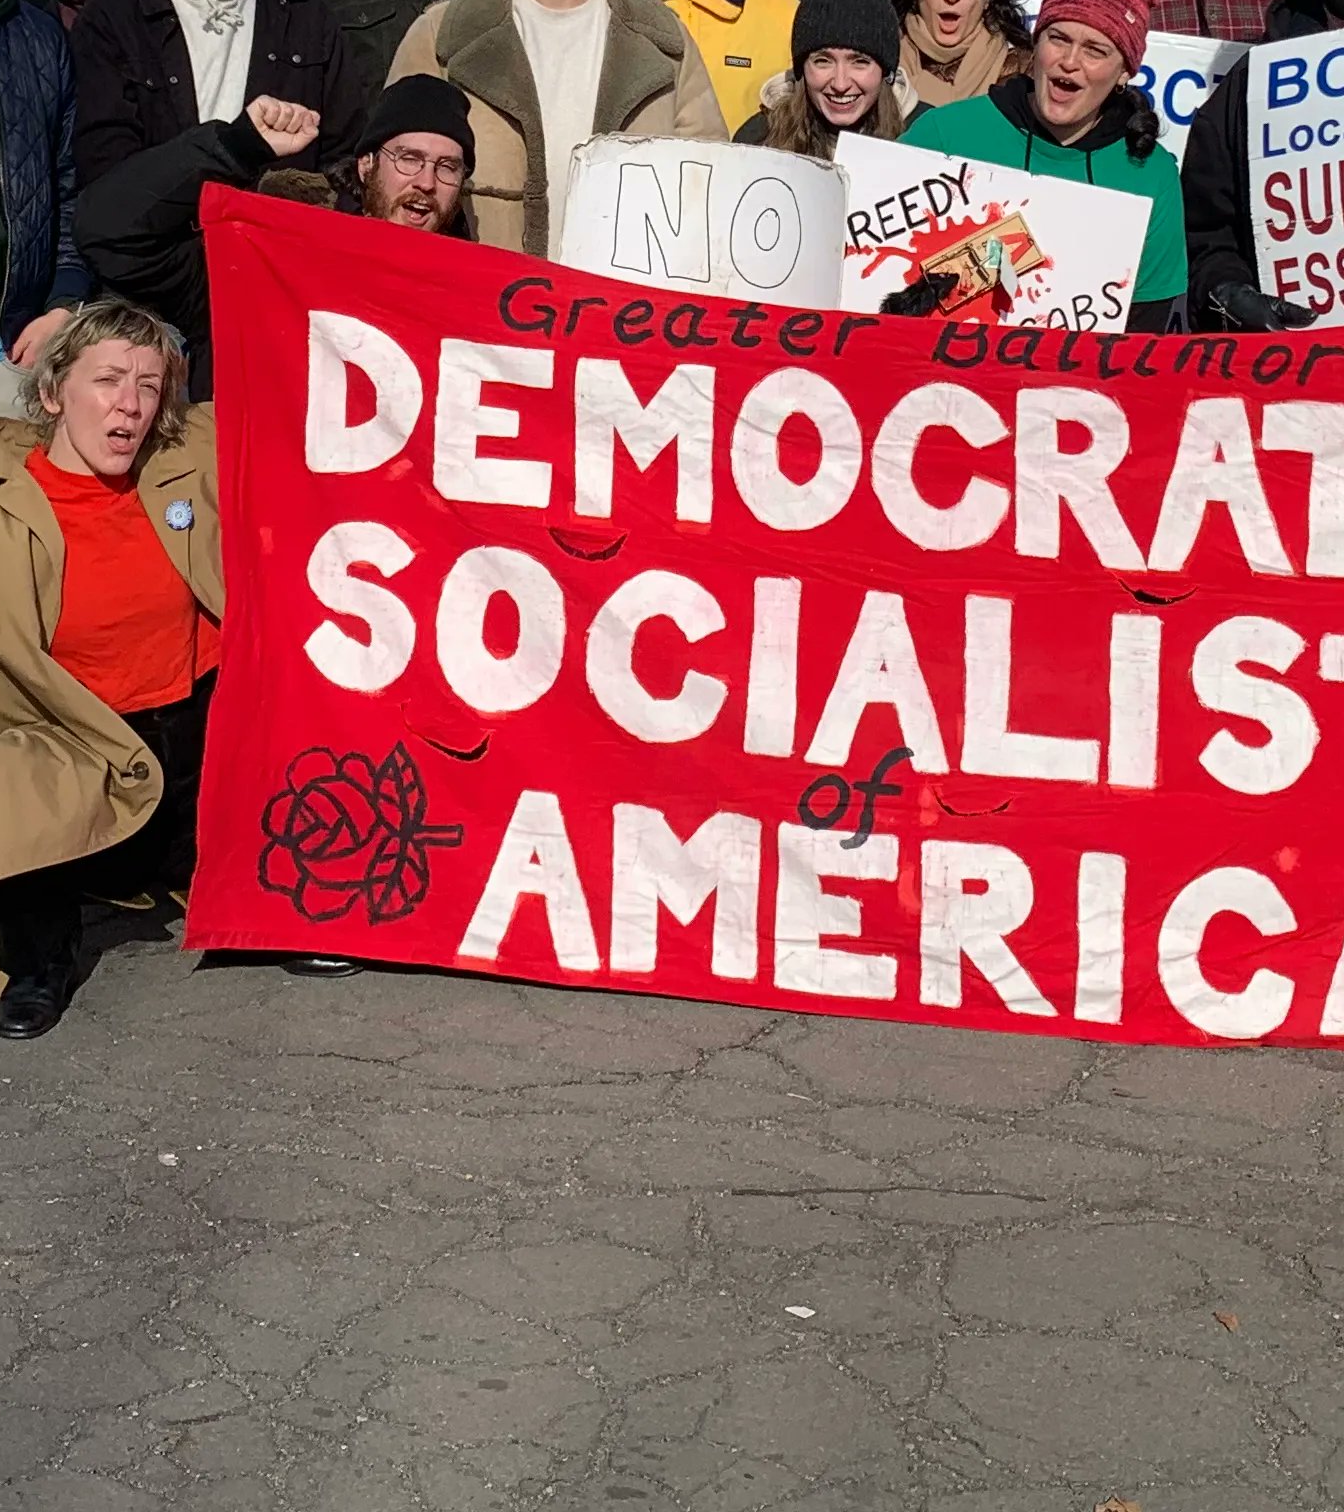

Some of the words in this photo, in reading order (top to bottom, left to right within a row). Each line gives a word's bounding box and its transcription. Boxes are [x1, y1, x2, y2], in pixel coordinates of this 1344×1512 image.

[610, 160, 802, 288] NO
[843, 162, 970, 260] REEDY
[498, 276, 880, 357] Greater
[1019, 281, 1123, 333] ABS
[799, 746, 915, 849] of
